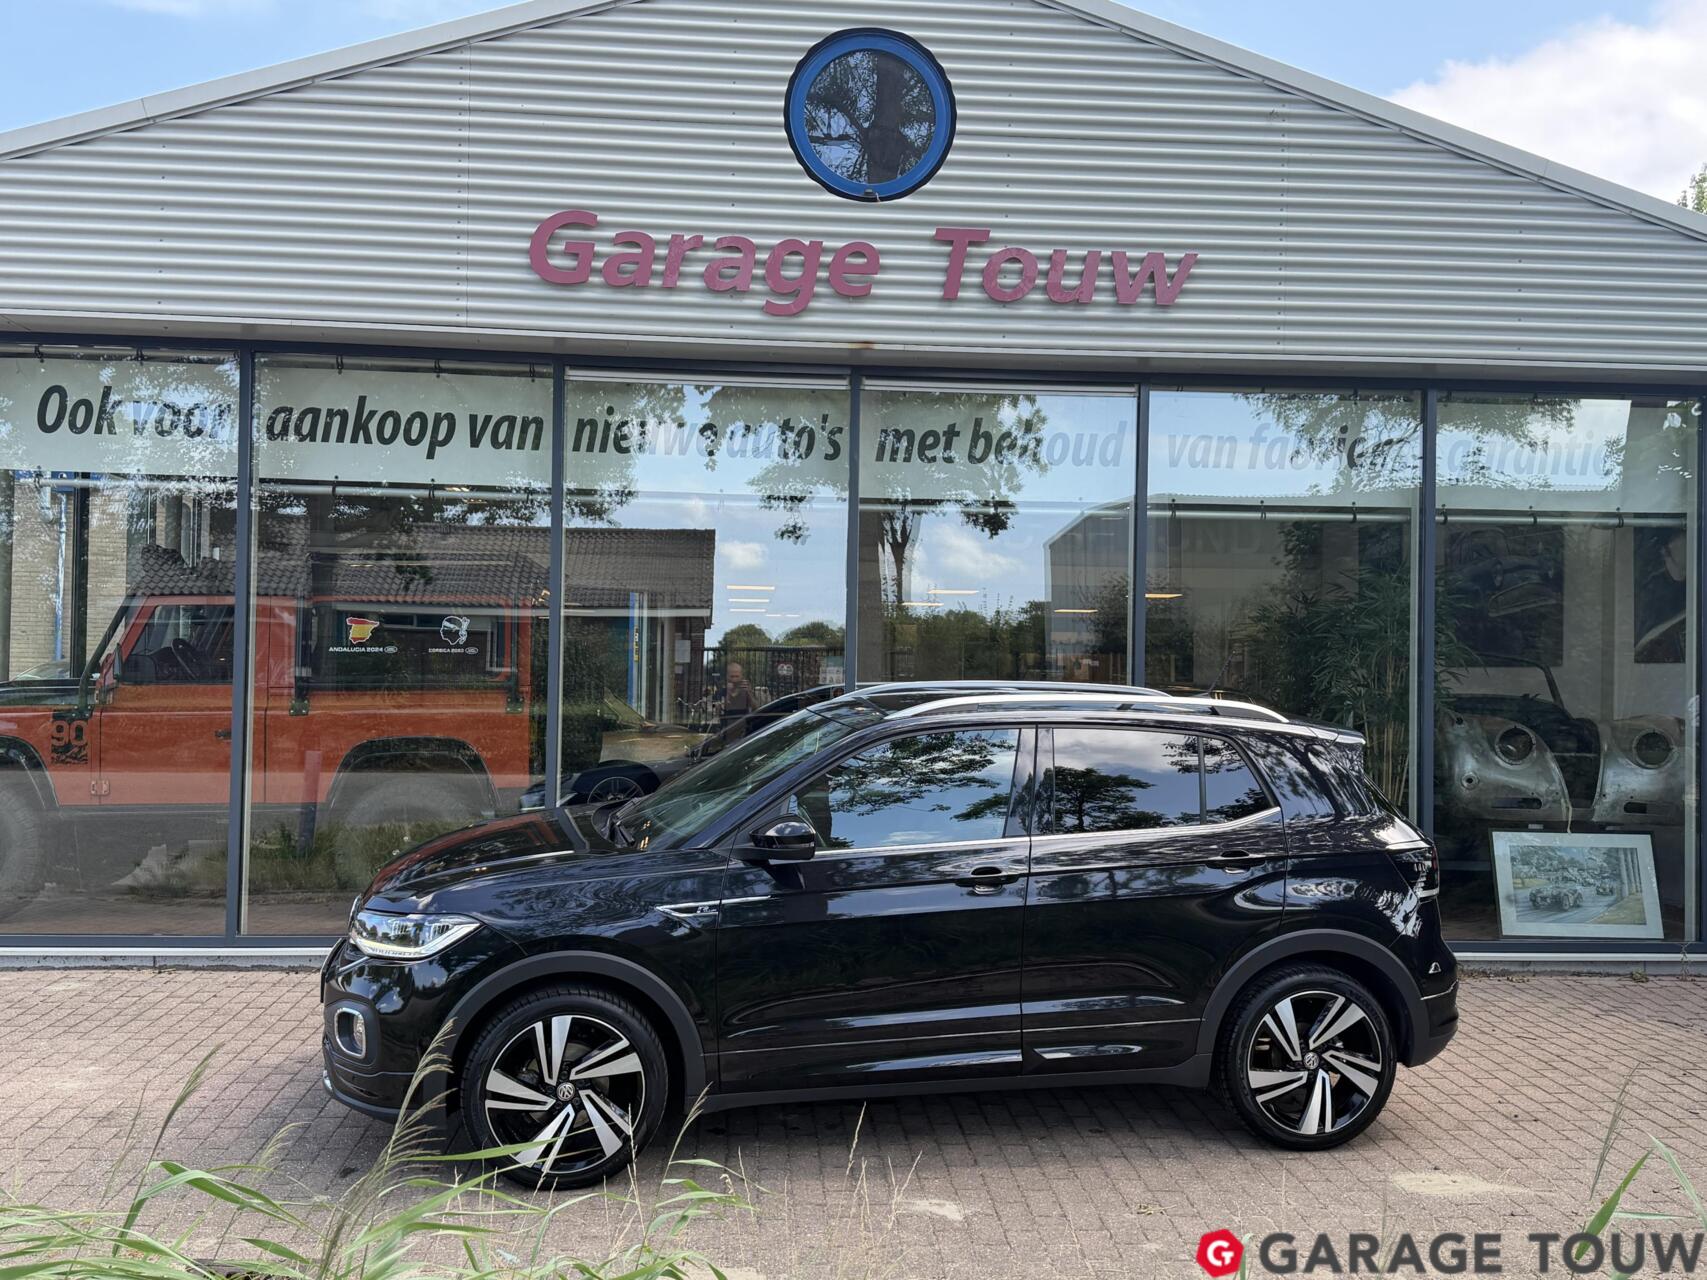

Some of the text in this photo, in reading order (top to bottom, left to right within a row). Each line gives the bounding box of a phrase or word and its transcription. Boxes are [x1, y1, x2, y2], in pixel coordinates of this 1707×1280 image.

[529, 210, 1199, 317] Garage Touw
[37, 384, 122, 435] Ook
[132, 400, 235, 439] voor
[266, 395, 456, 460] aankoop
[469, 413, 544, 451] van
[571, 405, 718, 457] nieuwe
[726, 413, 844, 461] auto's
[874, 422, 961, 464] met
[967, 417, 1128, 468] behoud
[1167, 431, 1237, 470] van
[1248, 423, 1408, 473] fabrie
[51, 720, 87, 746] 90
